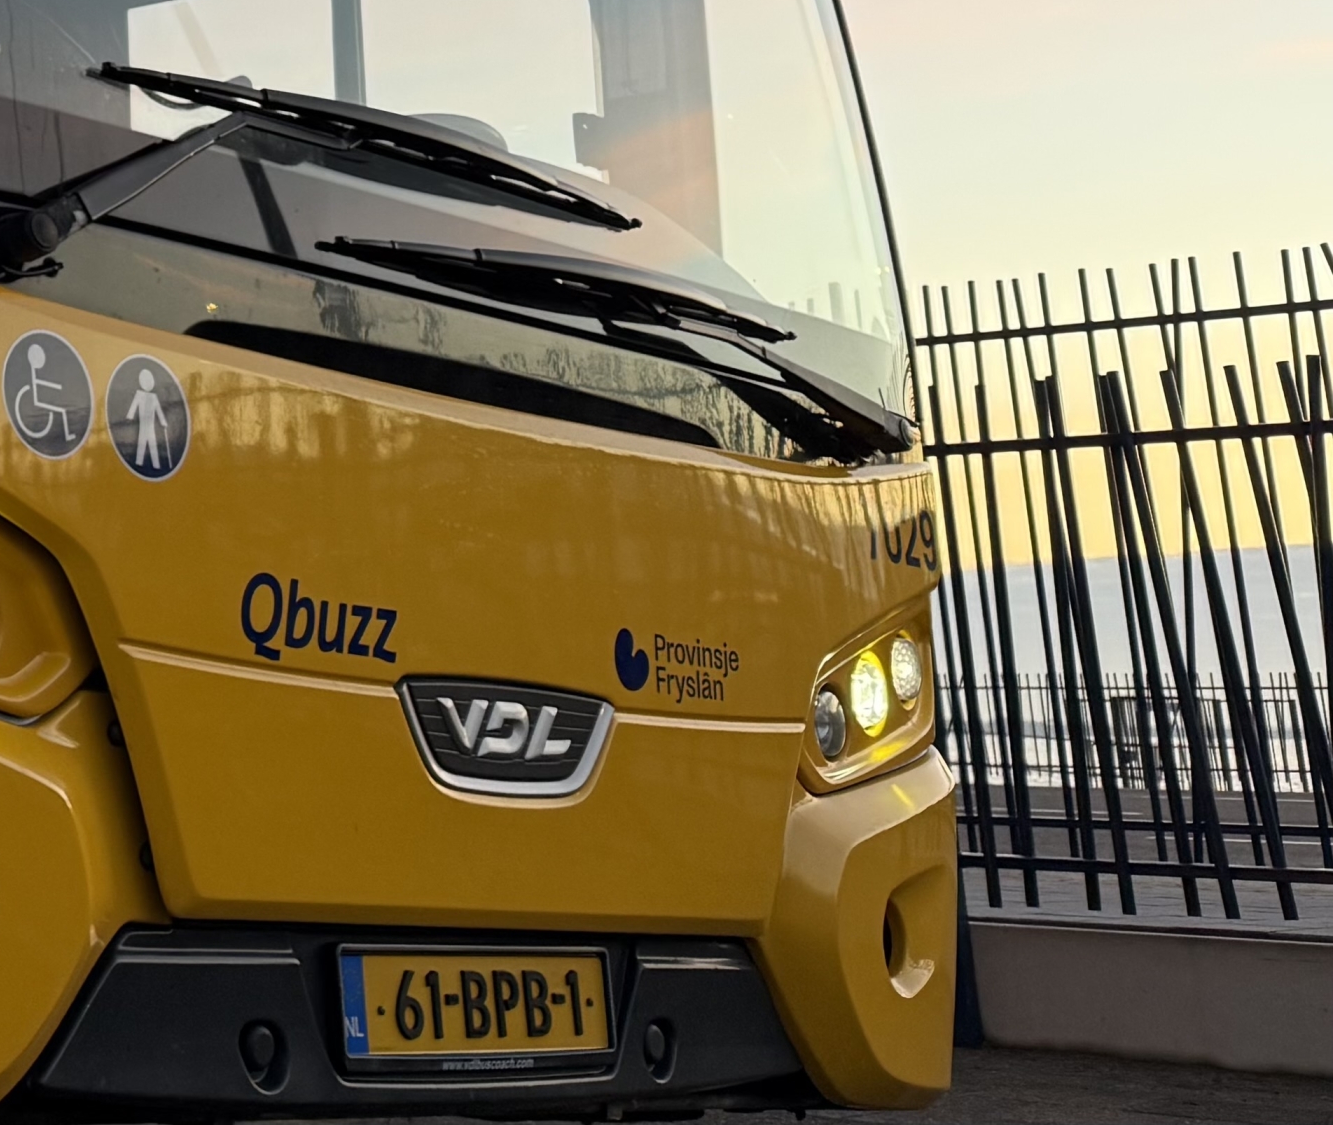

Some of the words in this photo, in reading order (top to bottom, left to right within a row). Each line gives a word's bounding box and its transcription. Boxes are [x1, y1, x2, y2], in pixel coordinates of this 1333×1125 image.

[240, 572, 398, 664] Qbuzz
[654, 633, 739, 677] Provinsje
[656, 665, 724, 703] Fryslân
[436, 696, 572, 760] VDL
[344, 1016, 365, 1038] NL
[395, 969, 584, 1040] 61-BPB-1
